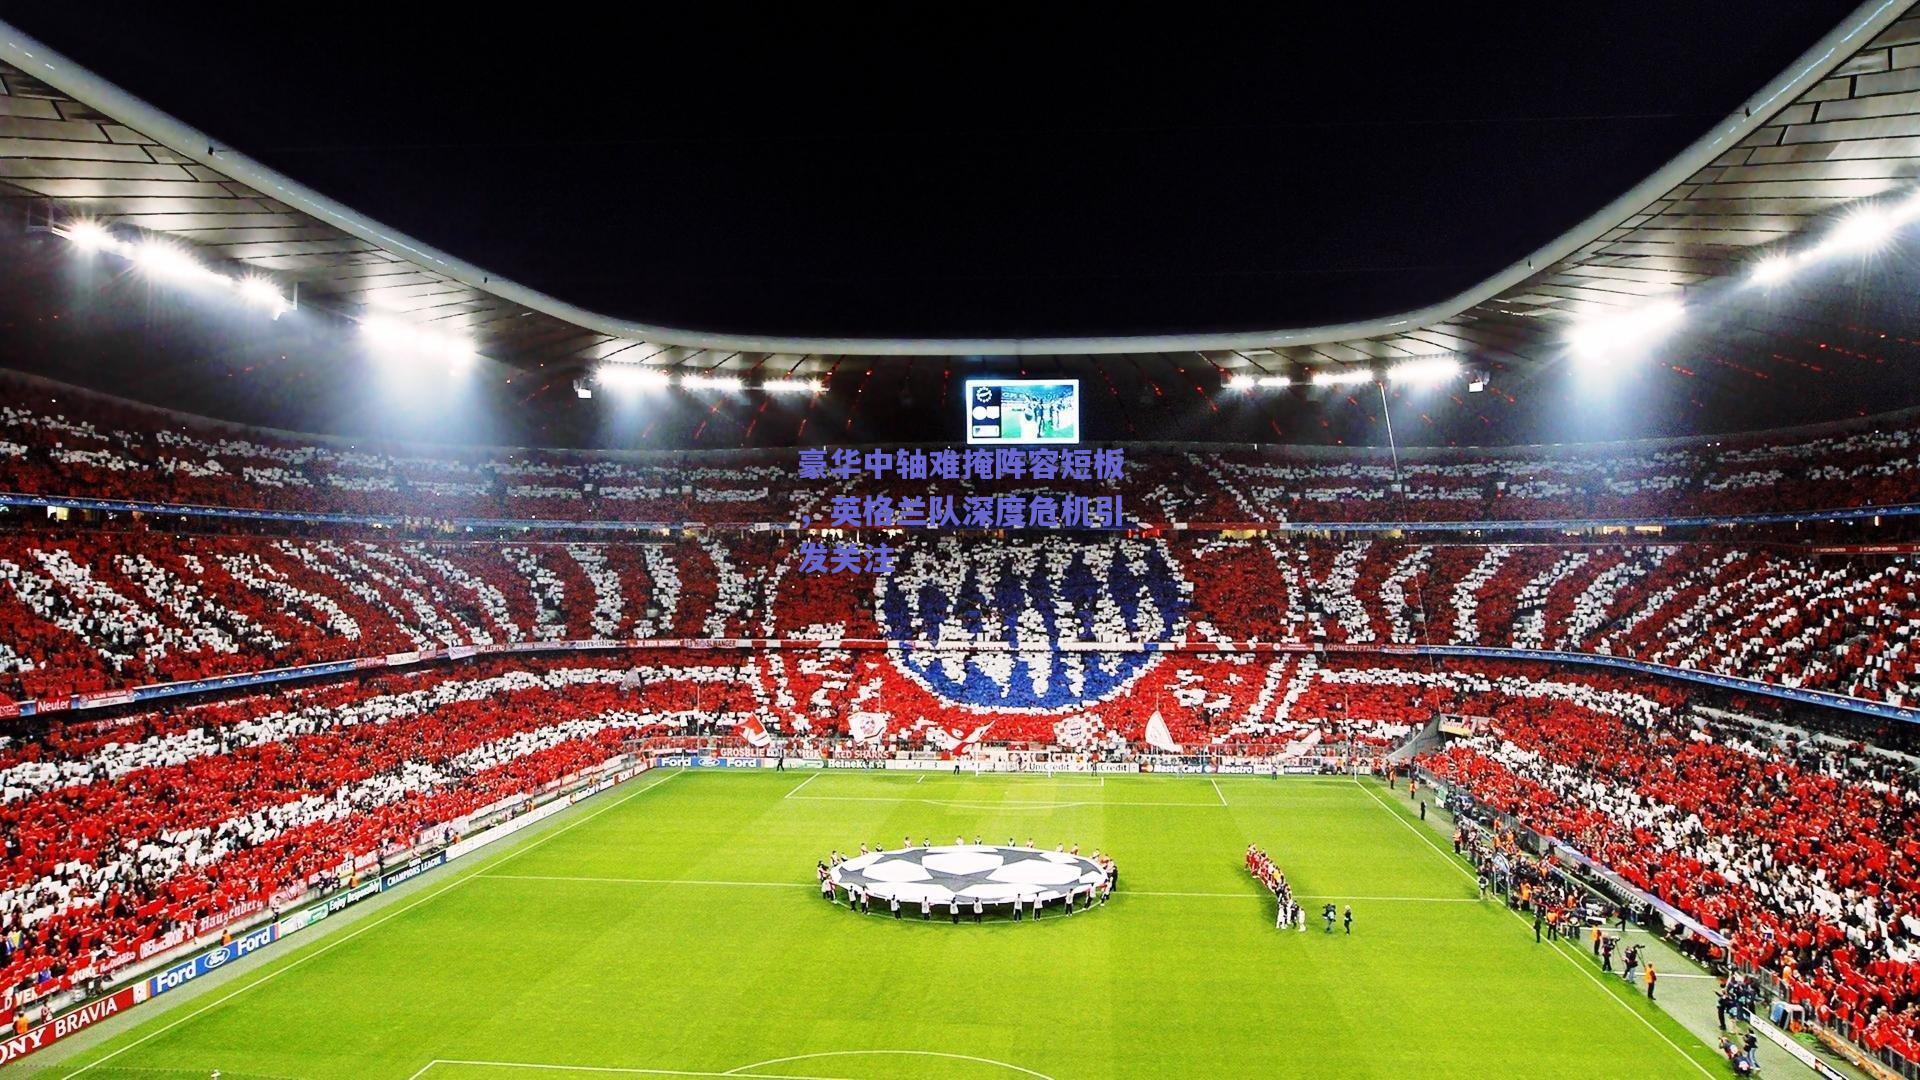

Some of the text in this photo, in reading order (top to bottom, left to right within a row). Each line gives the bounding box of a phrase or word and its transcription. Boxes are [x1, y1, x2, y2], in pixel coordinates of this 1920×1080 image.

[37, 700, 69, 713] Neuler
[661, 757, 692, 767] Ford
[726, 758, 757, 768] Ford
[828, 759, 875, 770] Heinekn
[387, 865, 421, 887] CHAMPIONS
[237, 928, 270, 955] Ford
[157, 960, 196, 992] Ford
[0, 997, 118, 1065] ONY BRAVIA
